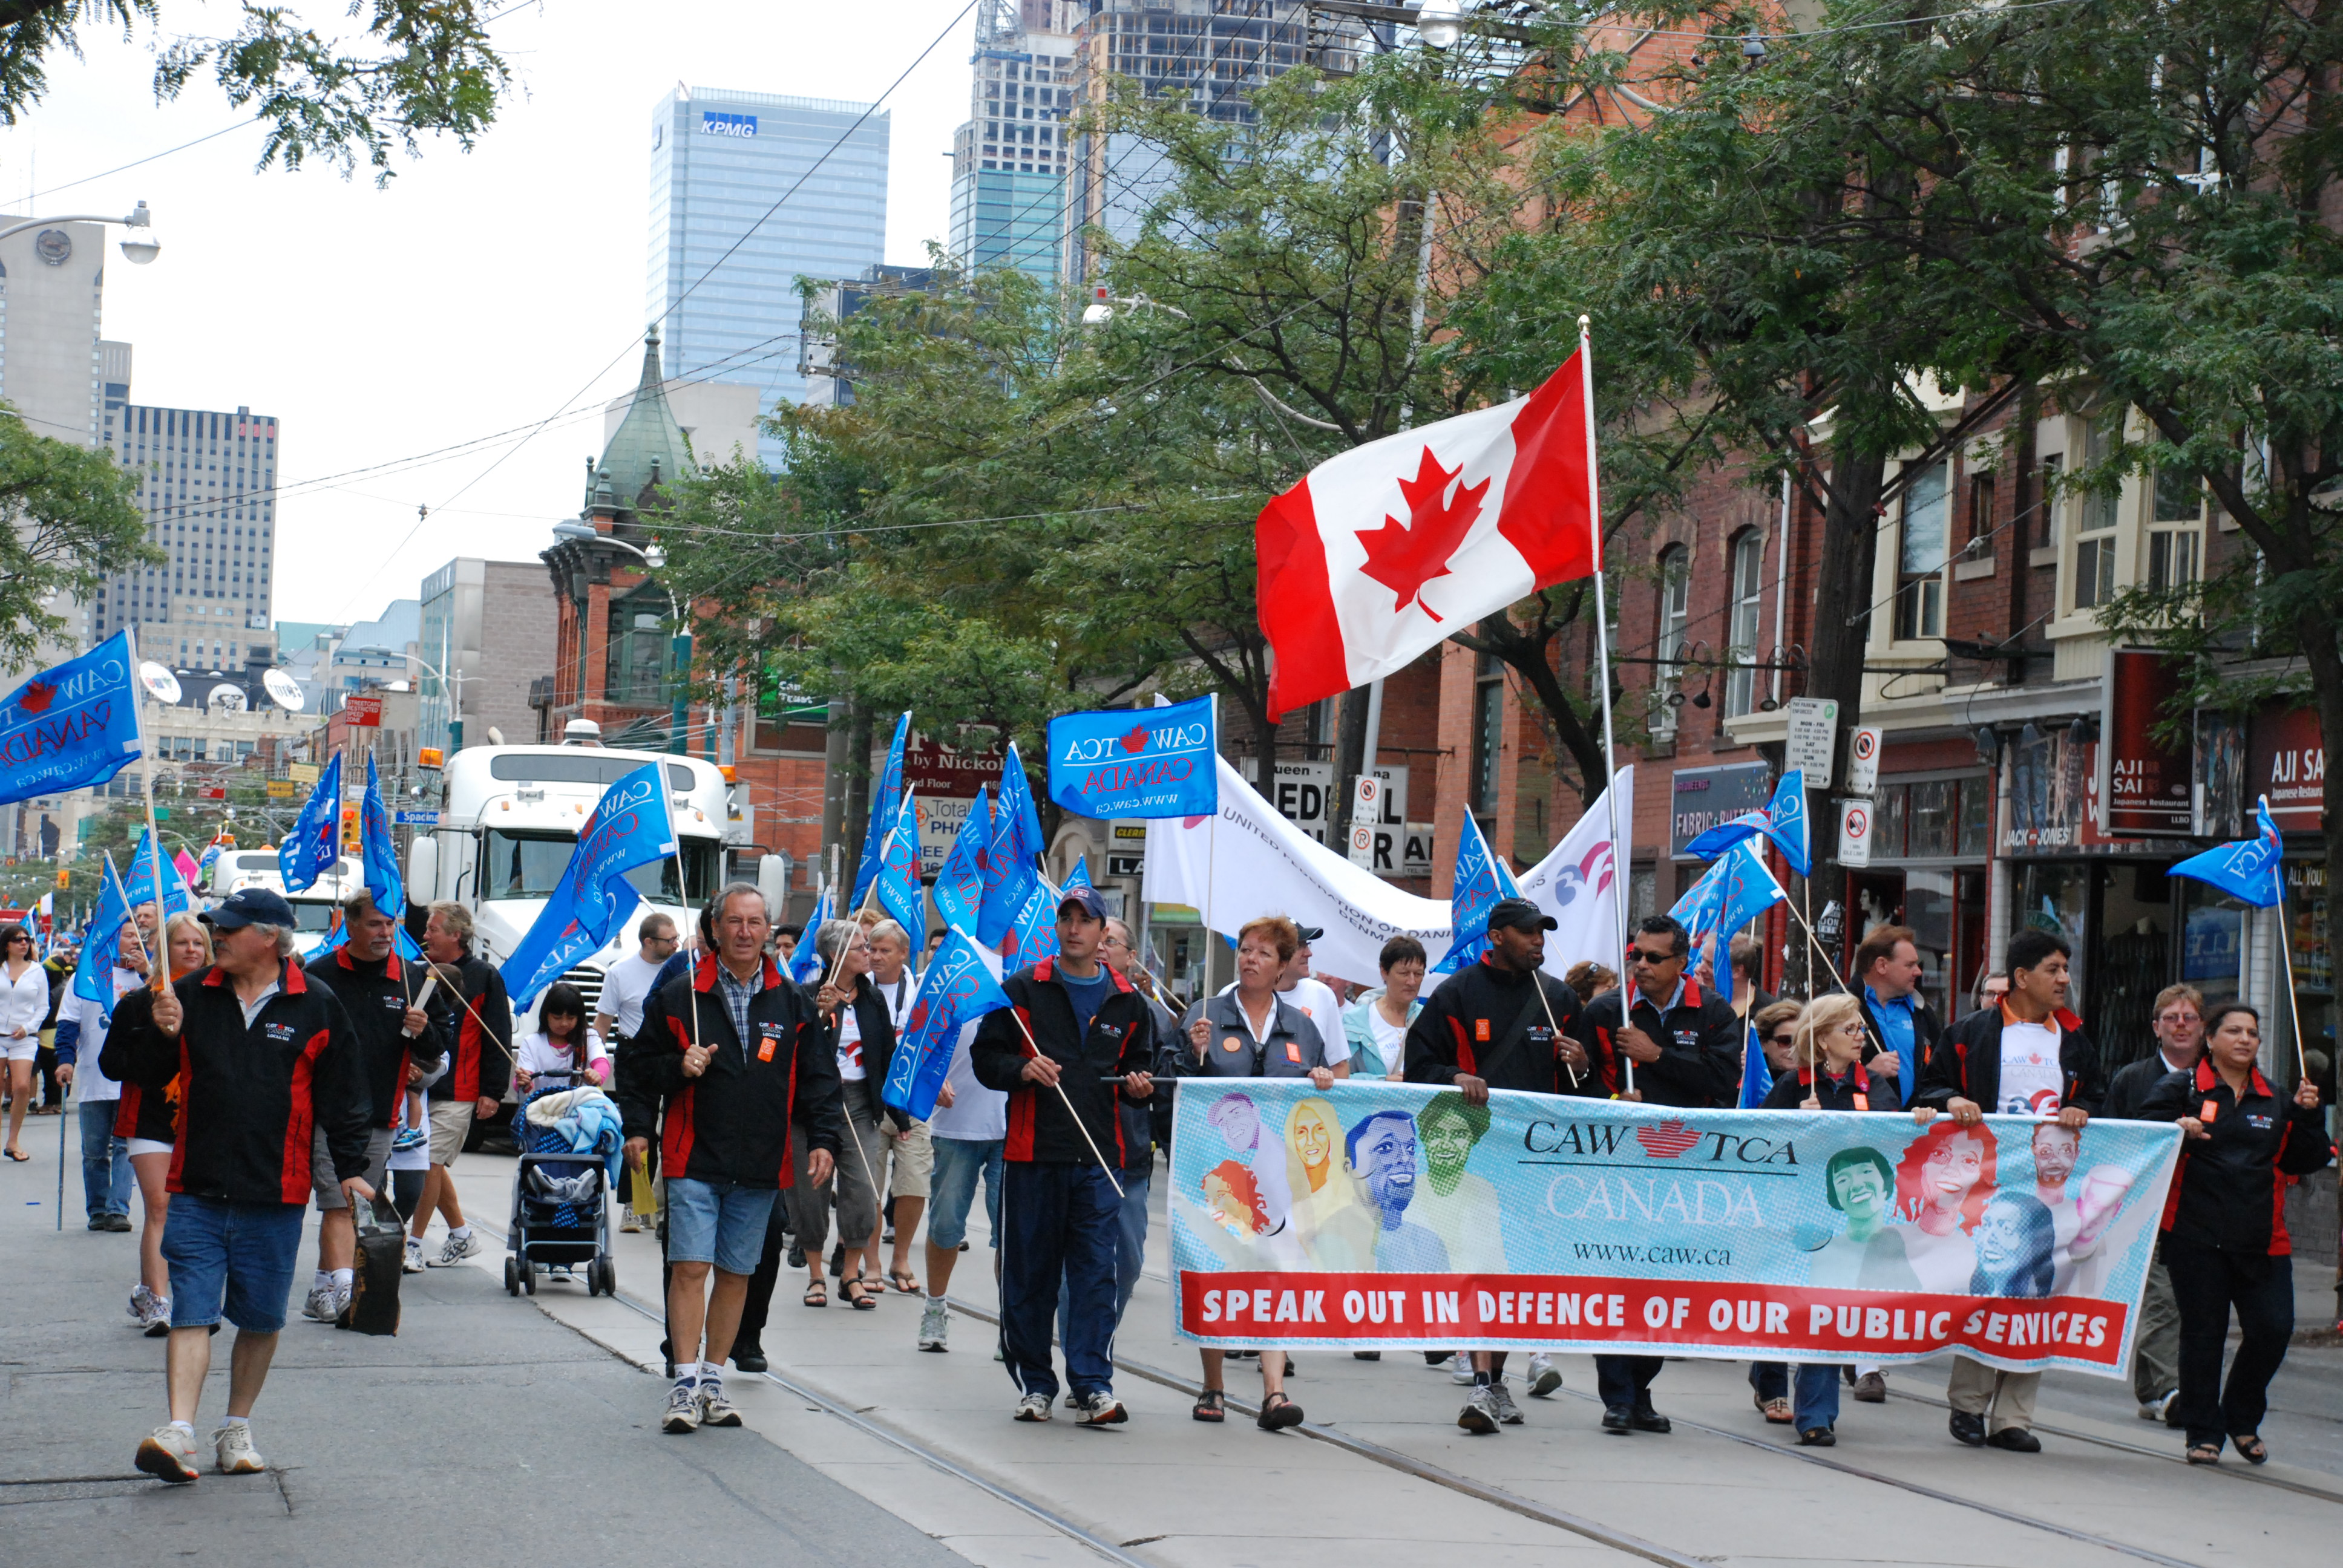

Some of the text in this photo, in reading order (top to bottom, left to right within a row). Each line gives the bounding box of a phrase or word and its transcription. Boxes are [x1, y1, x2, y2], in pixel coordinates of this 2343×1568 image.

[701, 120, 754, 138] KPMG
[348, 699, 381, 708] STREETCARS
[914, 754, 932, 769] by
[2114, 759, 2143, 775] AJI
[2272, 748, 2324, 783] AJI SA
[906, 778, 952, 789] 2nd Floor
[2113, 777, 2142, 794] SAI
[2272, 785, 2324, 802] Japanese Restaura
[2113, 798, 2189, 808] Japanese Restaurant
[962, 819, 982, 845] AW
[1116, 827, 1145, 837] CLEAN
[1676, 811, 1713, 837] FABRIC
[2004, 827, 2068, 846] JACK JONES
[1223, 806, 1279, 850] UNITED
[1378, 923, 1402, 934] OF
[1407, 930, 1453, 938] DANI
[2288, 866, 2322, 886] ALL YOU
[2004, 1054, 2028, 1063] CAW
[1524, 1121, 1800, 1165] CAW TCA
[1545, 1175, 1766, 1227] CANADA
[1573, 1243, 1731, 1266] www.caw.ca
[1202, 1289, 2108, 1348] SPEAK OUT IN DEFENCE OF OUR PUBLIC SERVICES
